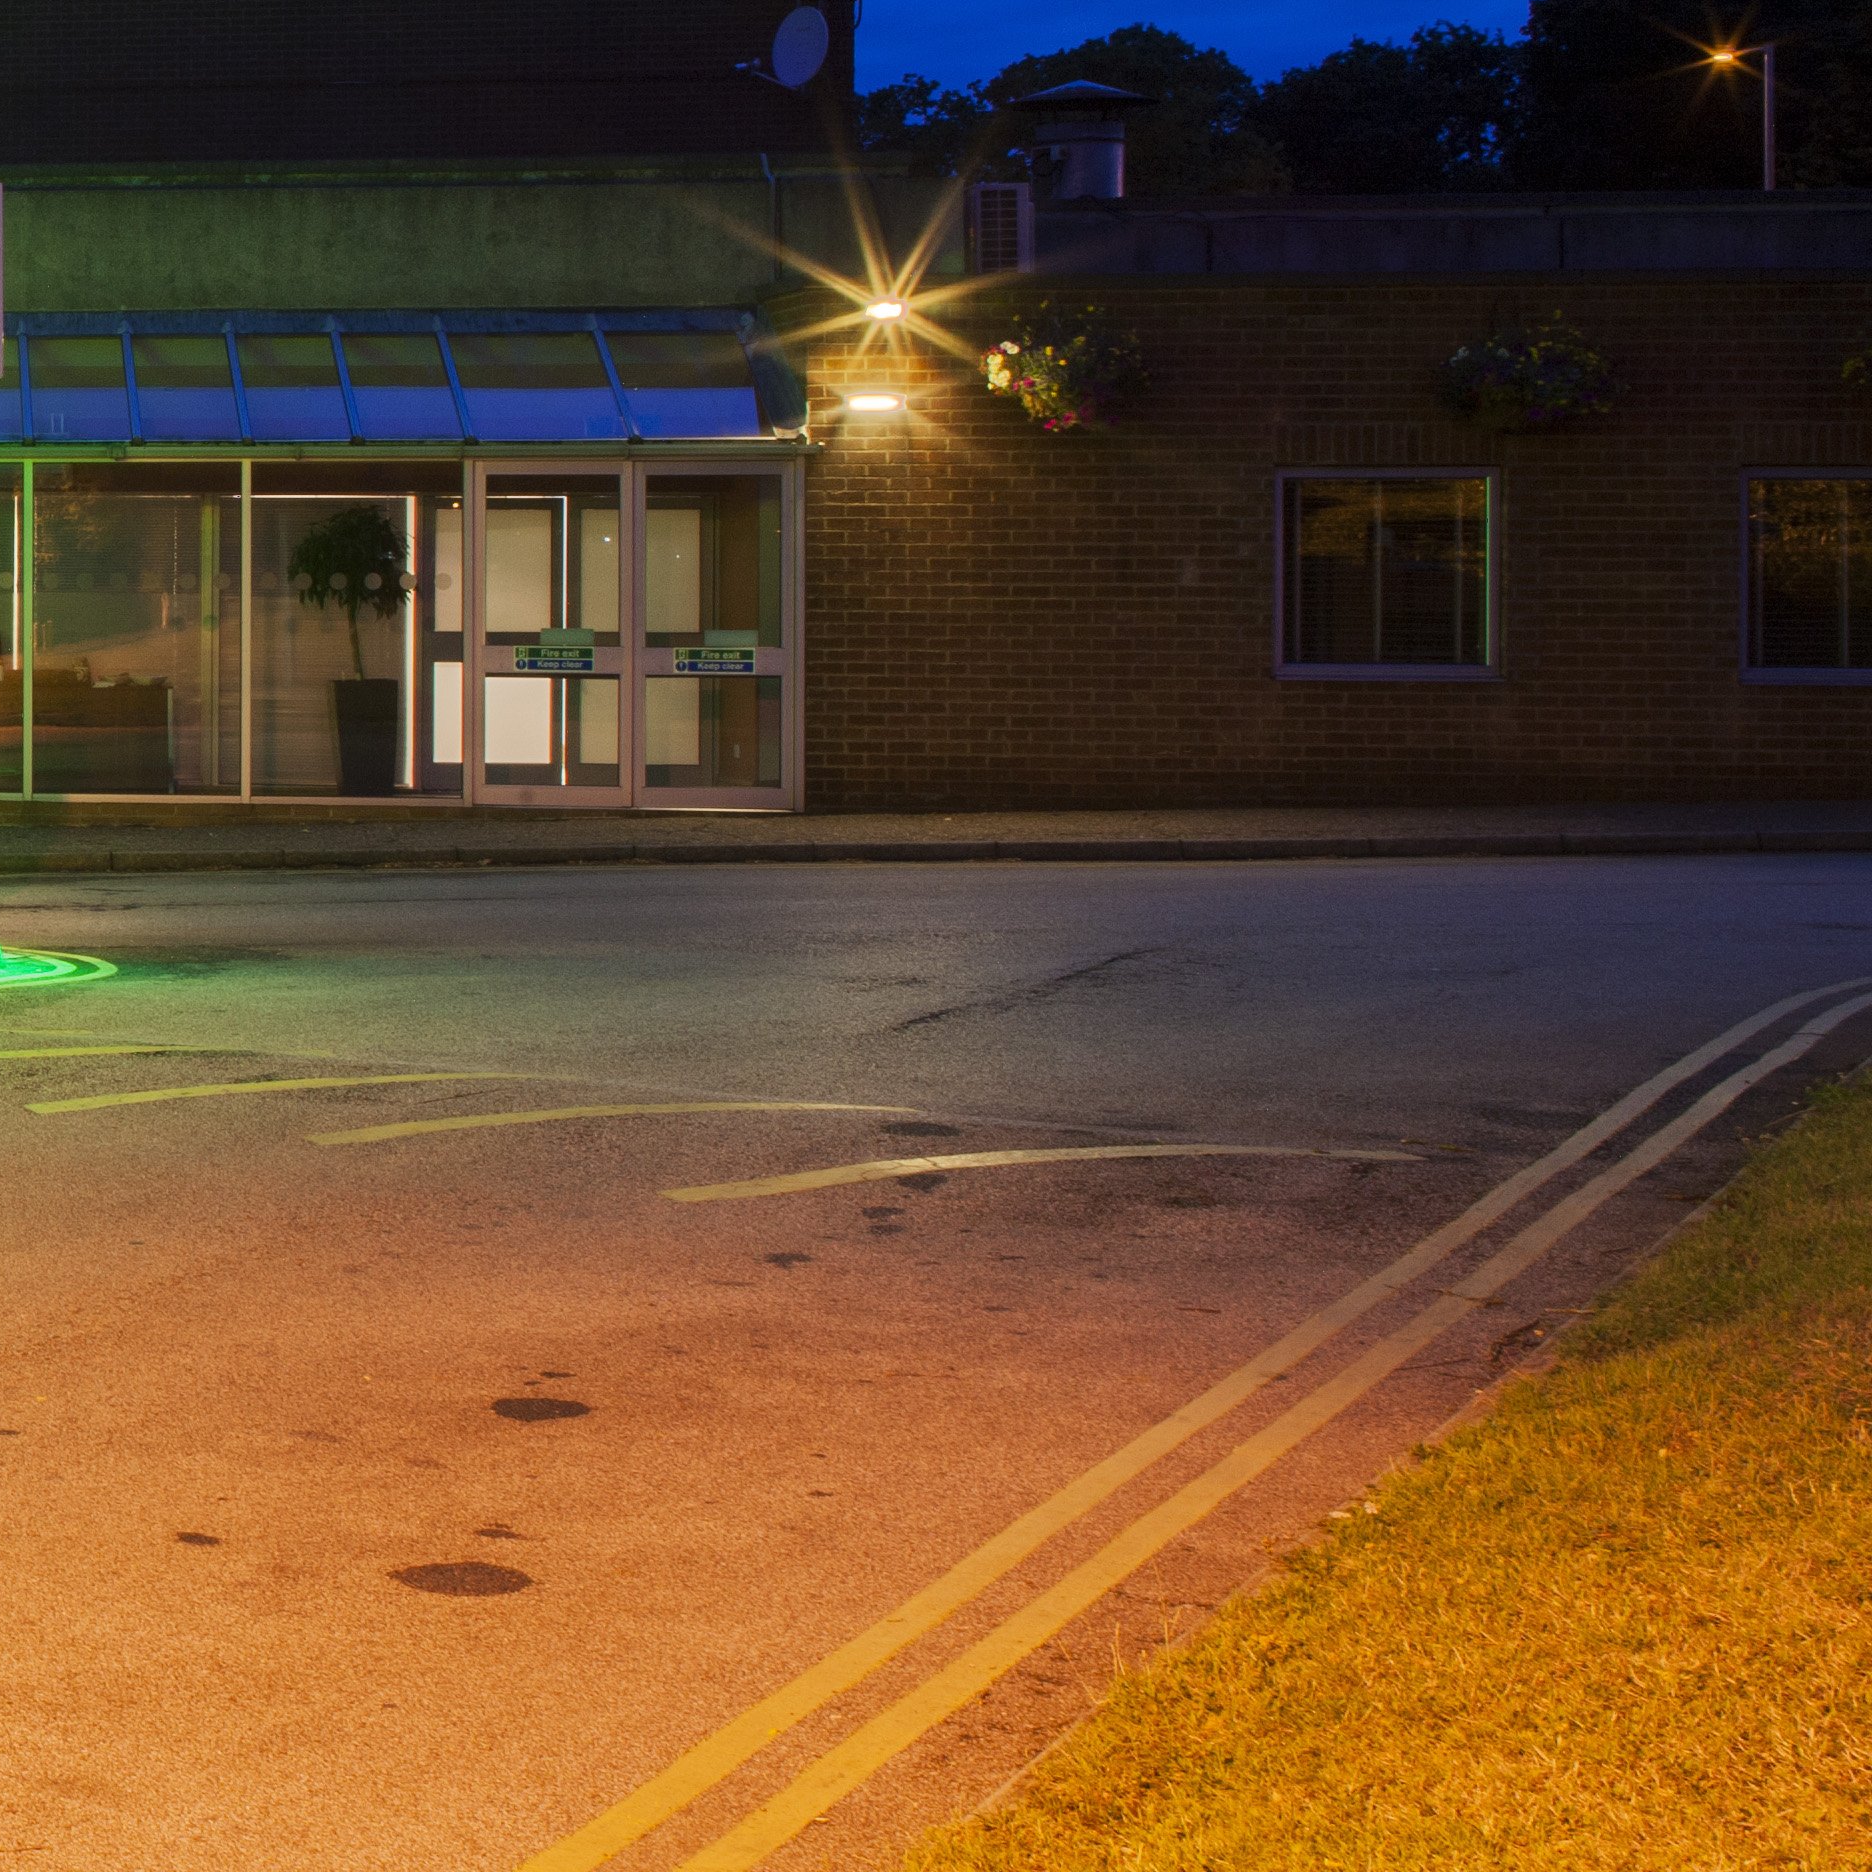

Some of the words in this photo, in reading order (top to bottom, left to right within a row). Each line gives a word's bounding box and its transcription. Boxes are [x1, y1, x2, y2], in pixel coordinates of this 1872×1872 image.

[541, 649, 561, 658] Fire
[562, 649, 580, 658] exit
[701, 651, 720, 659] Fire
